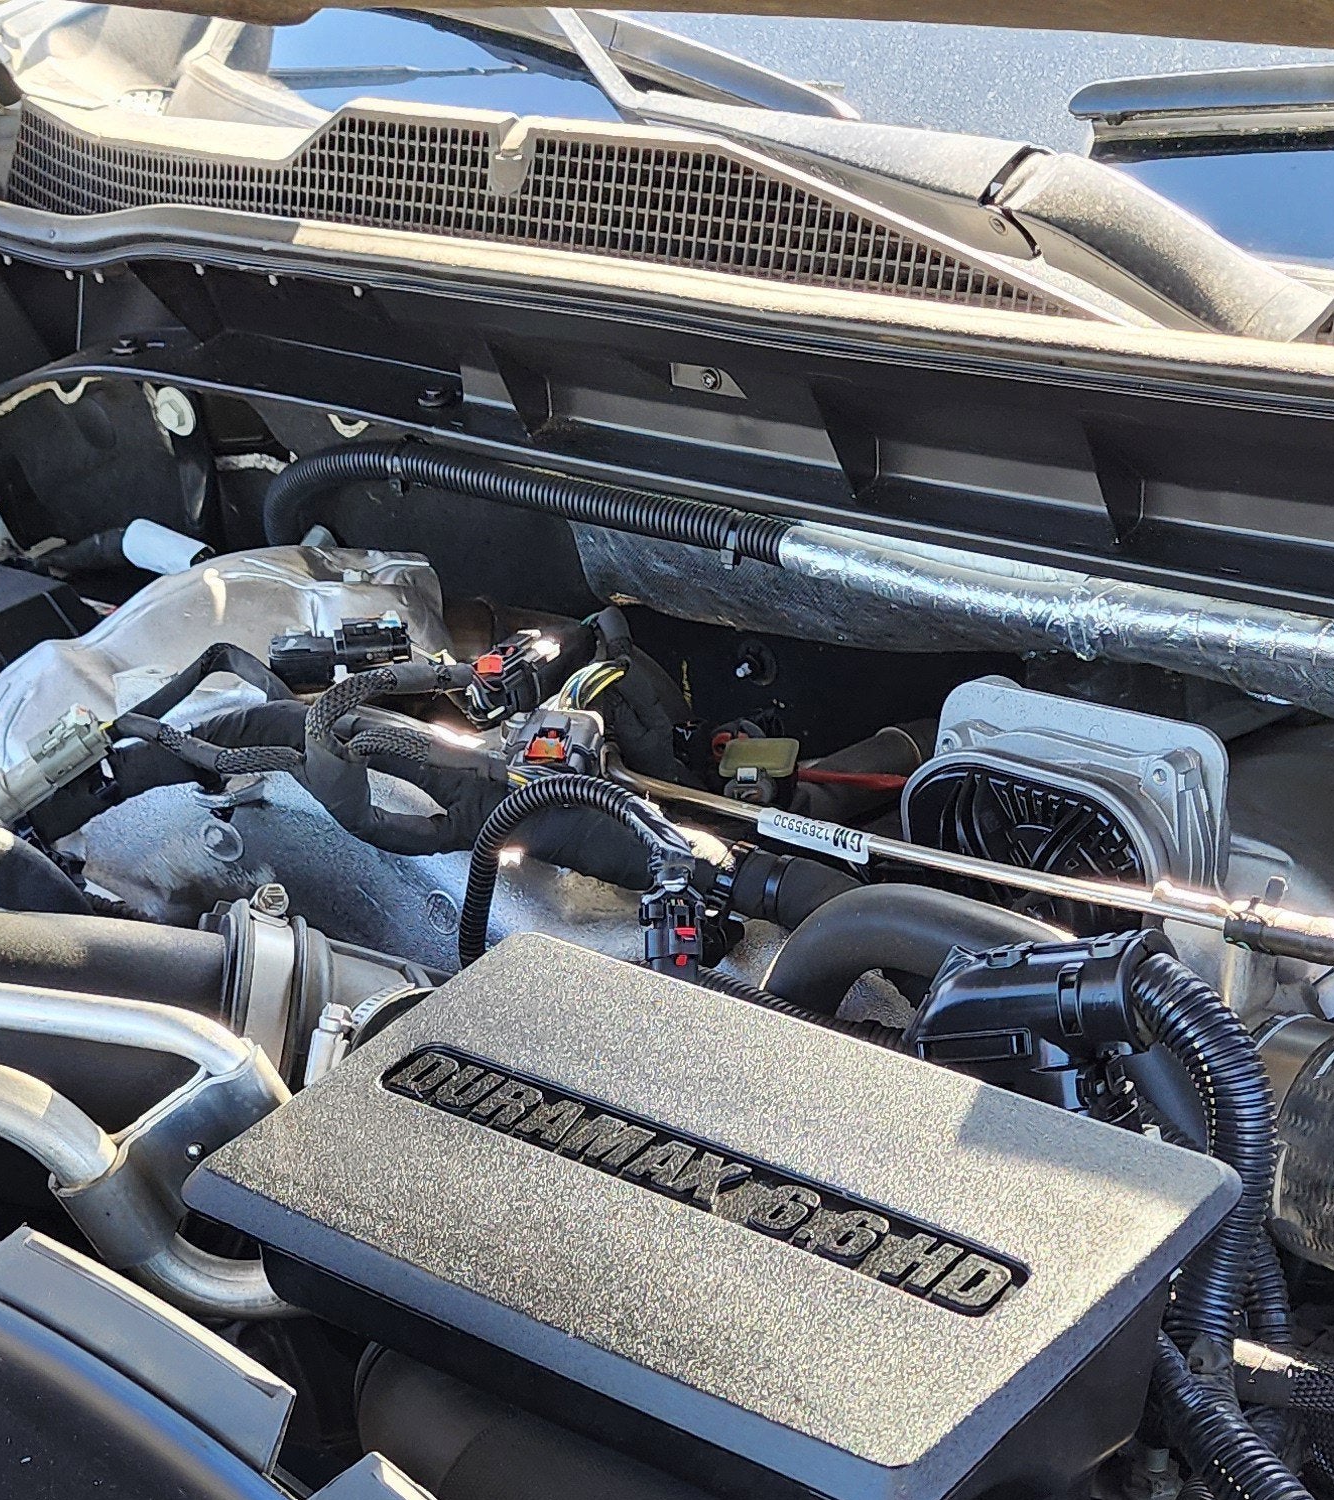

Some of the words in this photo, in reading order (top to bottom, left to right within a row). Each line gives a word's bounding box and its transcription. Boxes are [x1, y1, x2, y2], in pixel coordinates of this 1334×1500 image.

[773, 814, 830, 841] 12695930
[832, 827, 863, 852] GM
[389, 1051, 752, 1211] DURAMAX
[747, 1183, 890, 1261] 6.6
[877, 1232, 1014, 1313] HD
